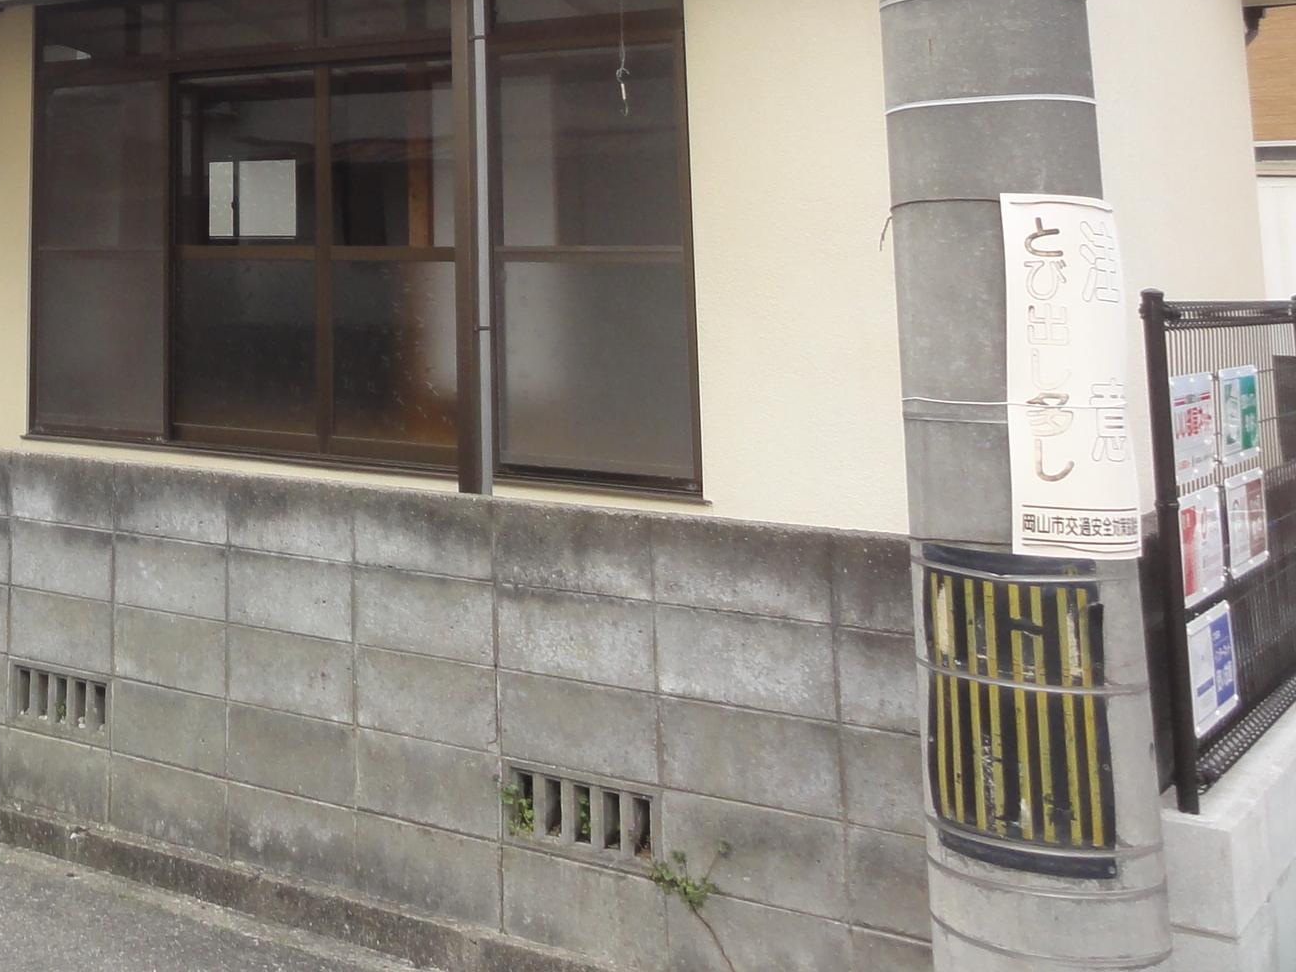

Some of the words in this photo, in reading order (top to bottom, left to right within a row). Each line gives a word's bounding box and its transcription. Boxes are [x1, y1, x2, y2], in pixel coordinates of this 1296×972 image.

[1023, 216, 1075, 483] とび出し多し
